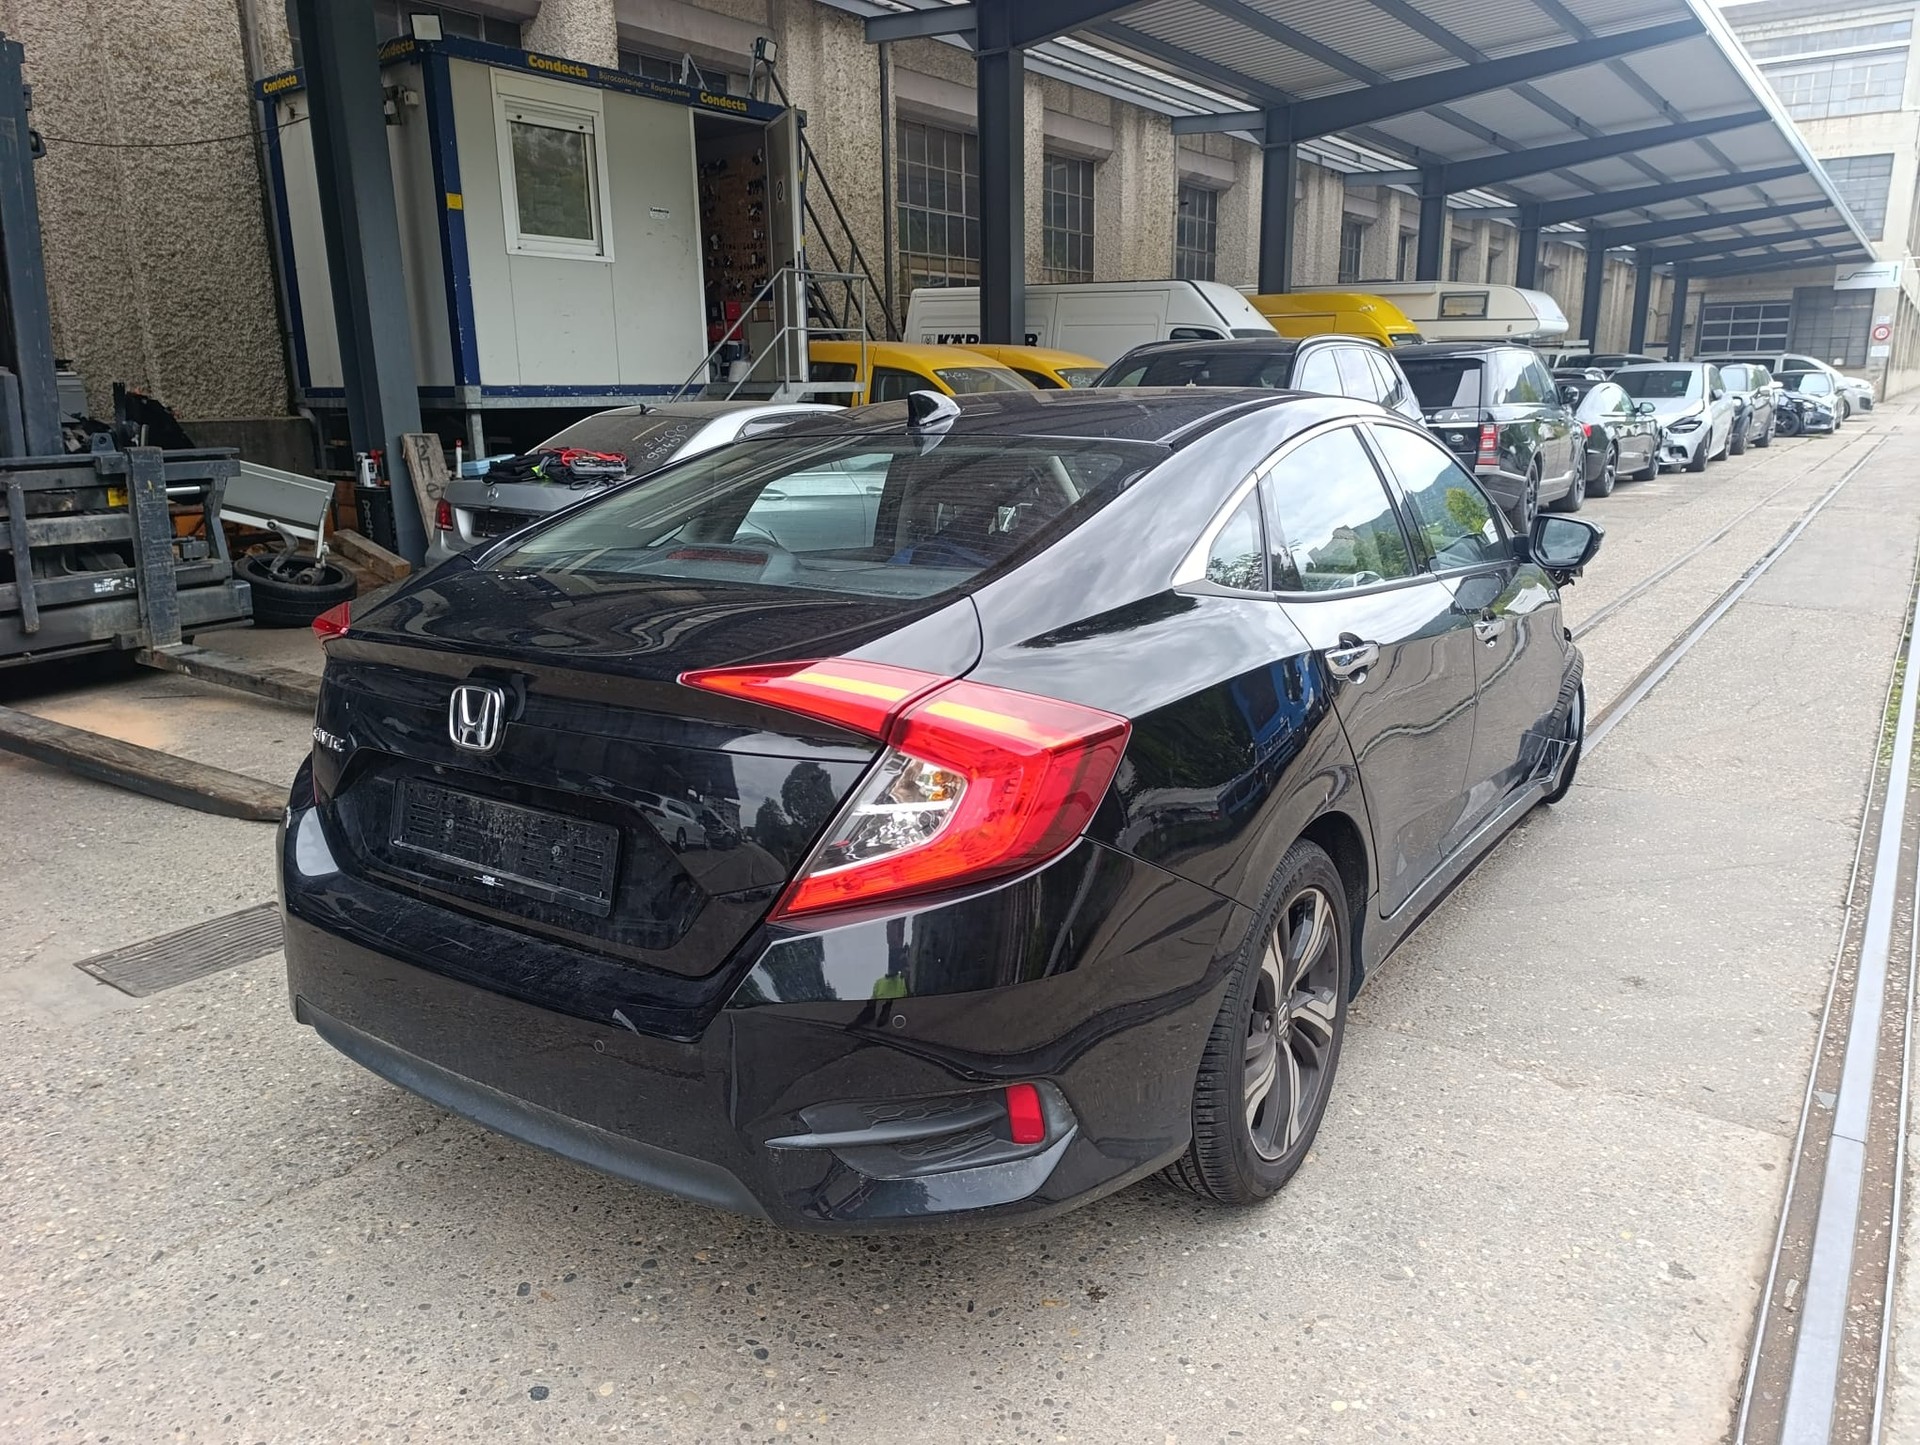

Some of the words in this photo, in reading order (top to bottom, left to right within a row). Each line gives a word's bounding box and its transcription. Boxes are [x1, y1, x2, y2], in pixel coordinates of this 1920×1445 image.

[528, 54, 588, 79] Condecta
[263, 74, 298, 94] Condecta
[700, 91, 748, 112] Condecta
